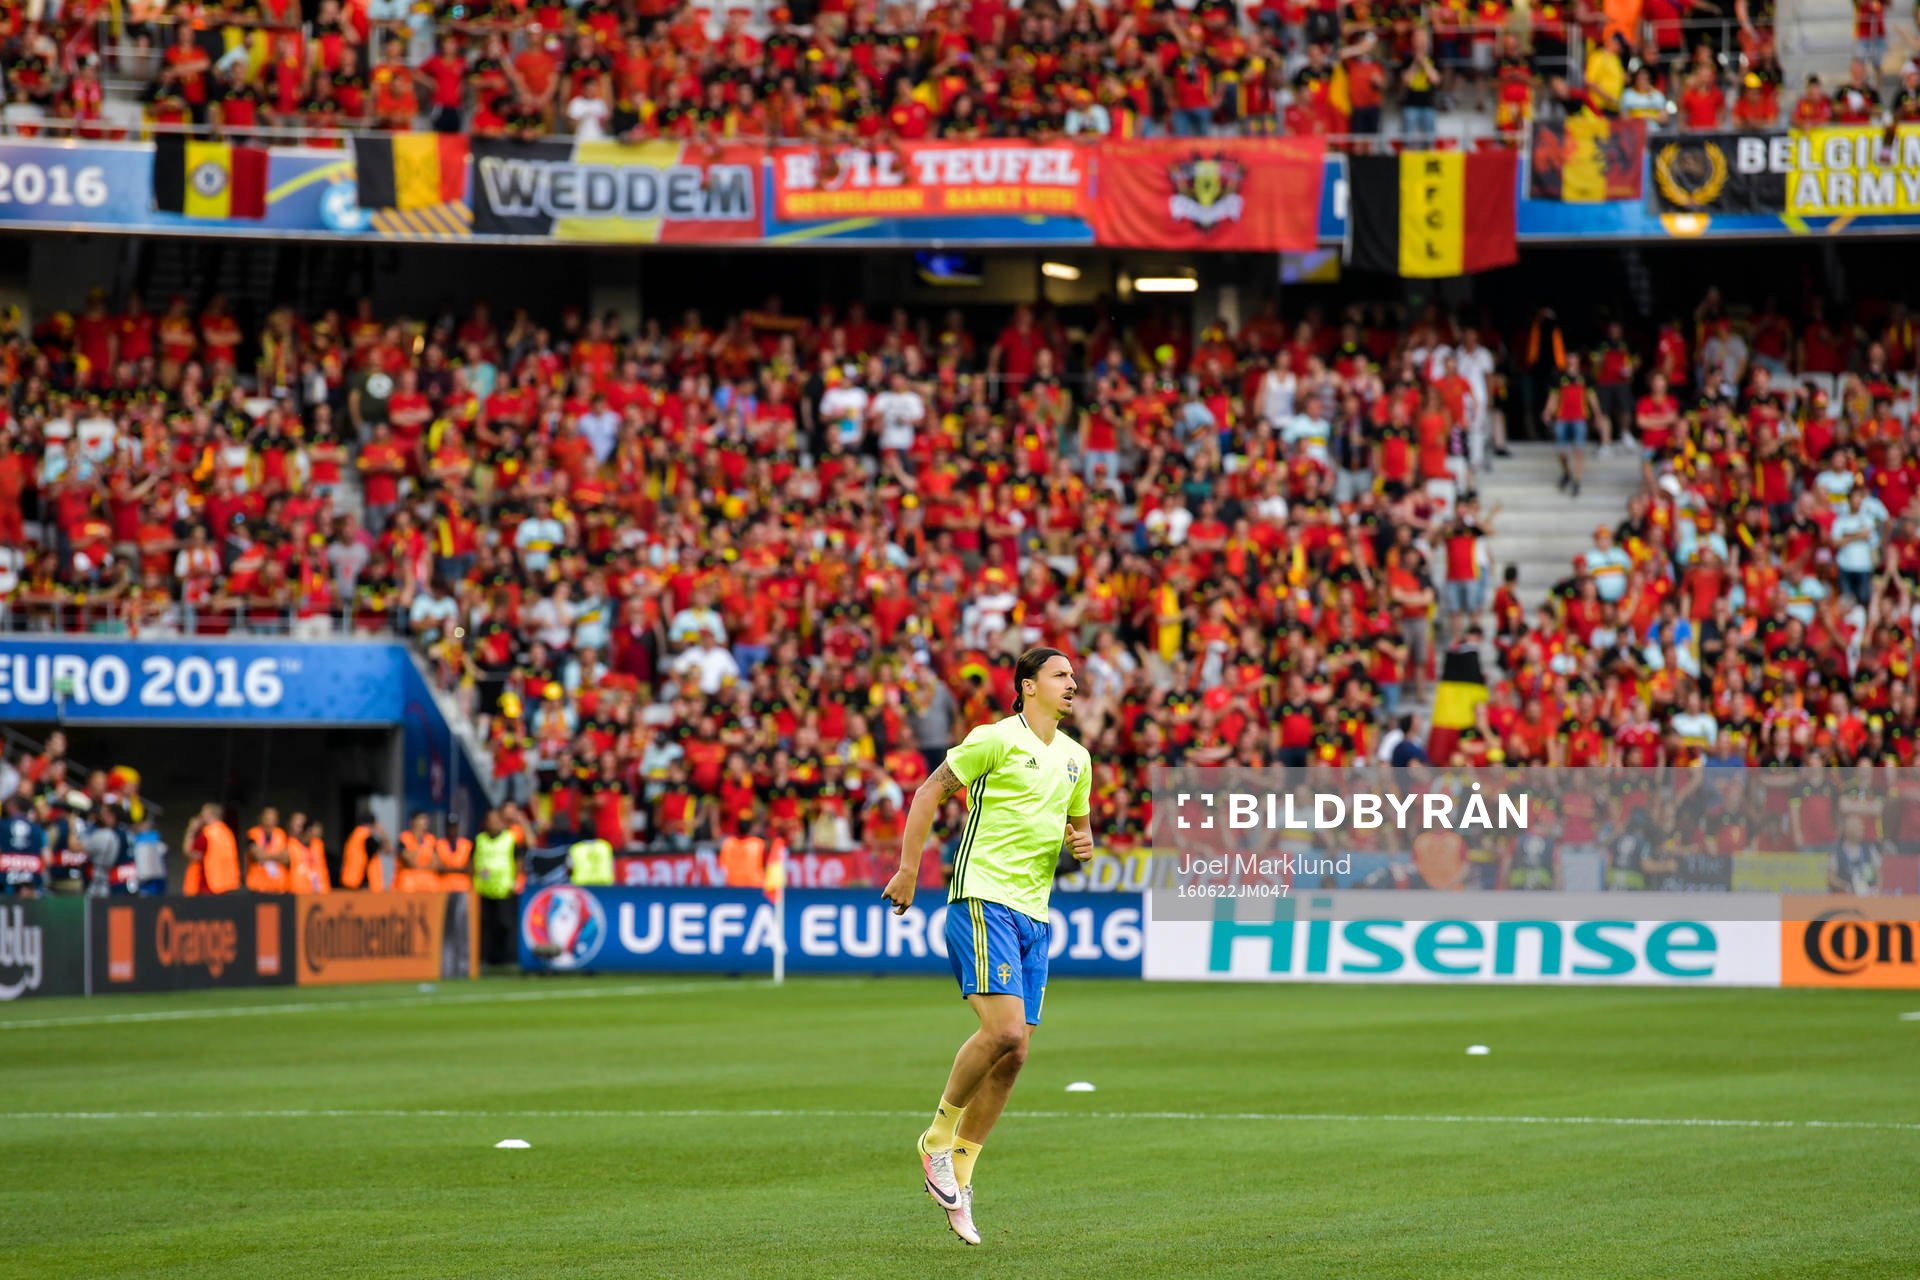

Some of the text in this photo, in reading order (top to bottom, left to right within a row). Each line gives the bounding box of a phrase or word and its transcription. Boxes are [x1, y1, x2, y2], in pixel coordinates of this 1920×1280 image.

[480, 157, 754, 220] WEDDEM
[912, 149, 1080, 185] TEUFEL
[140, 656, 283, 707] 2016
[155, 906, 238, 977] Orange
[619, 902, 788, 955] UEFA
[1209, 897, 1718, 977] Hisense
